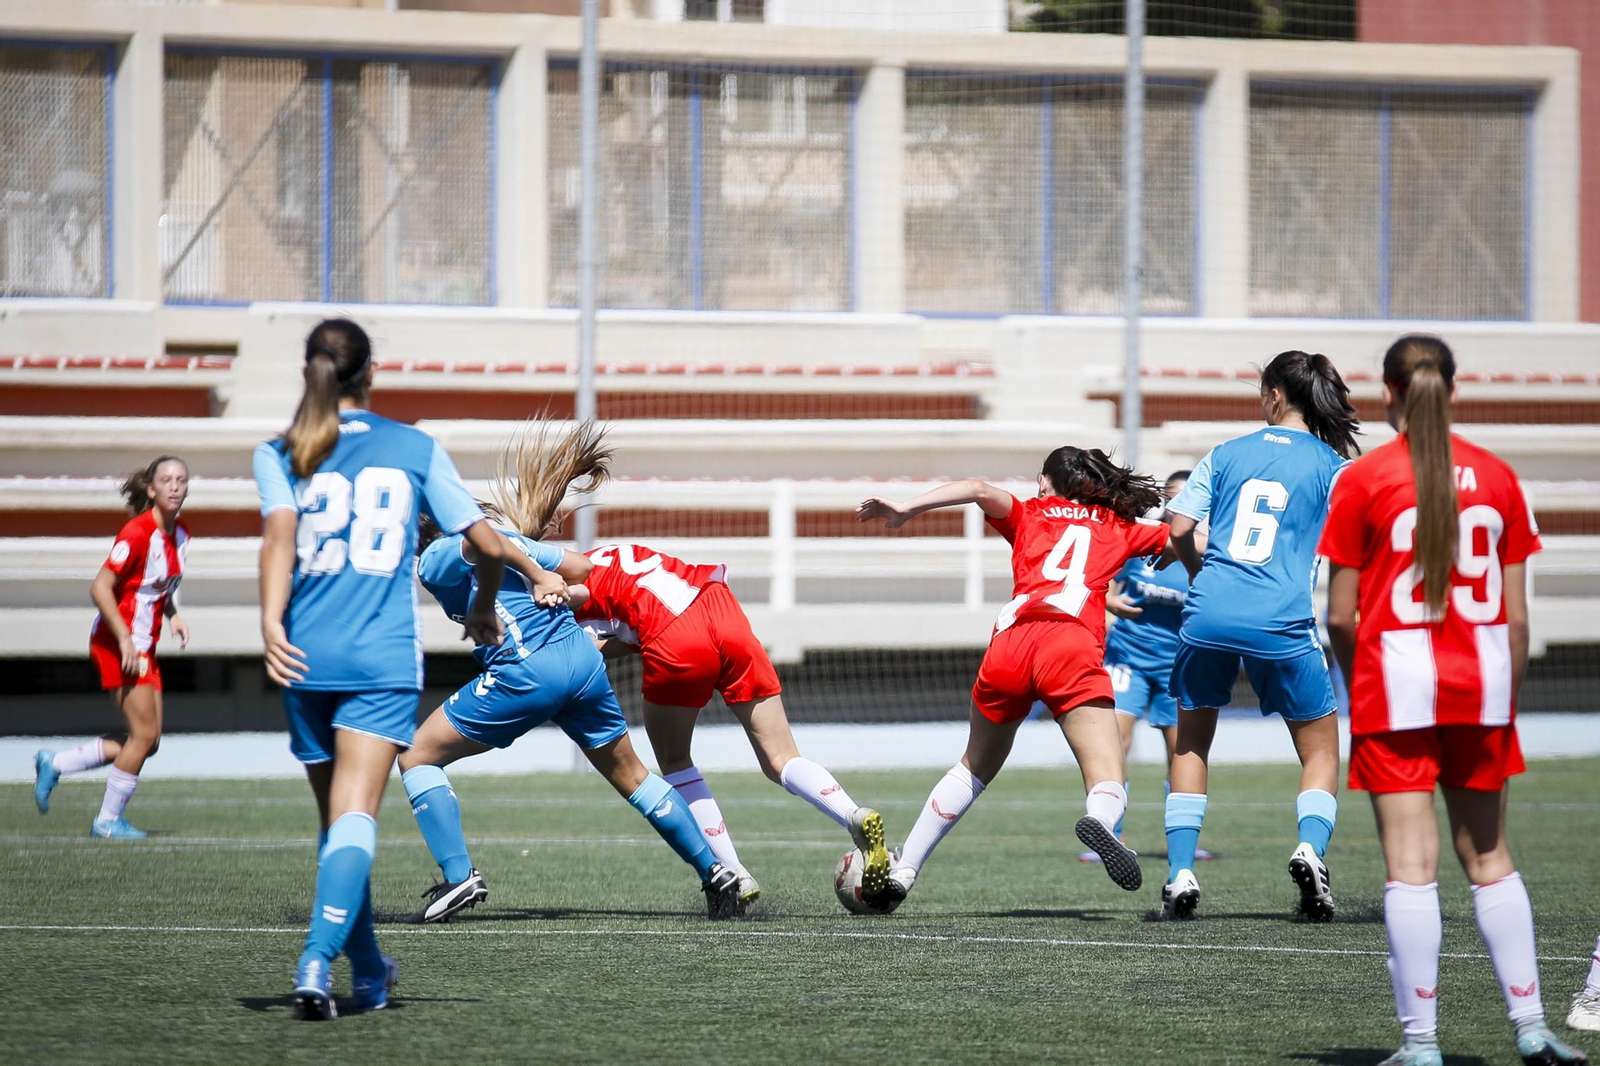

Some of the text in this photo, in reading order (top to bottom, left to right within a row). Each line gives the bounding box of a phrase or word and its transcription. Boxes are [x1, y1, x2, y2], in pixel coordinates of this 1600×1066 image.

[293, 466, 414, 579] 28
[1041, 523, 1092, 588] 4
[1227, 477, 1290, 567] 6
[1391, 504, 1504, 625] 29
